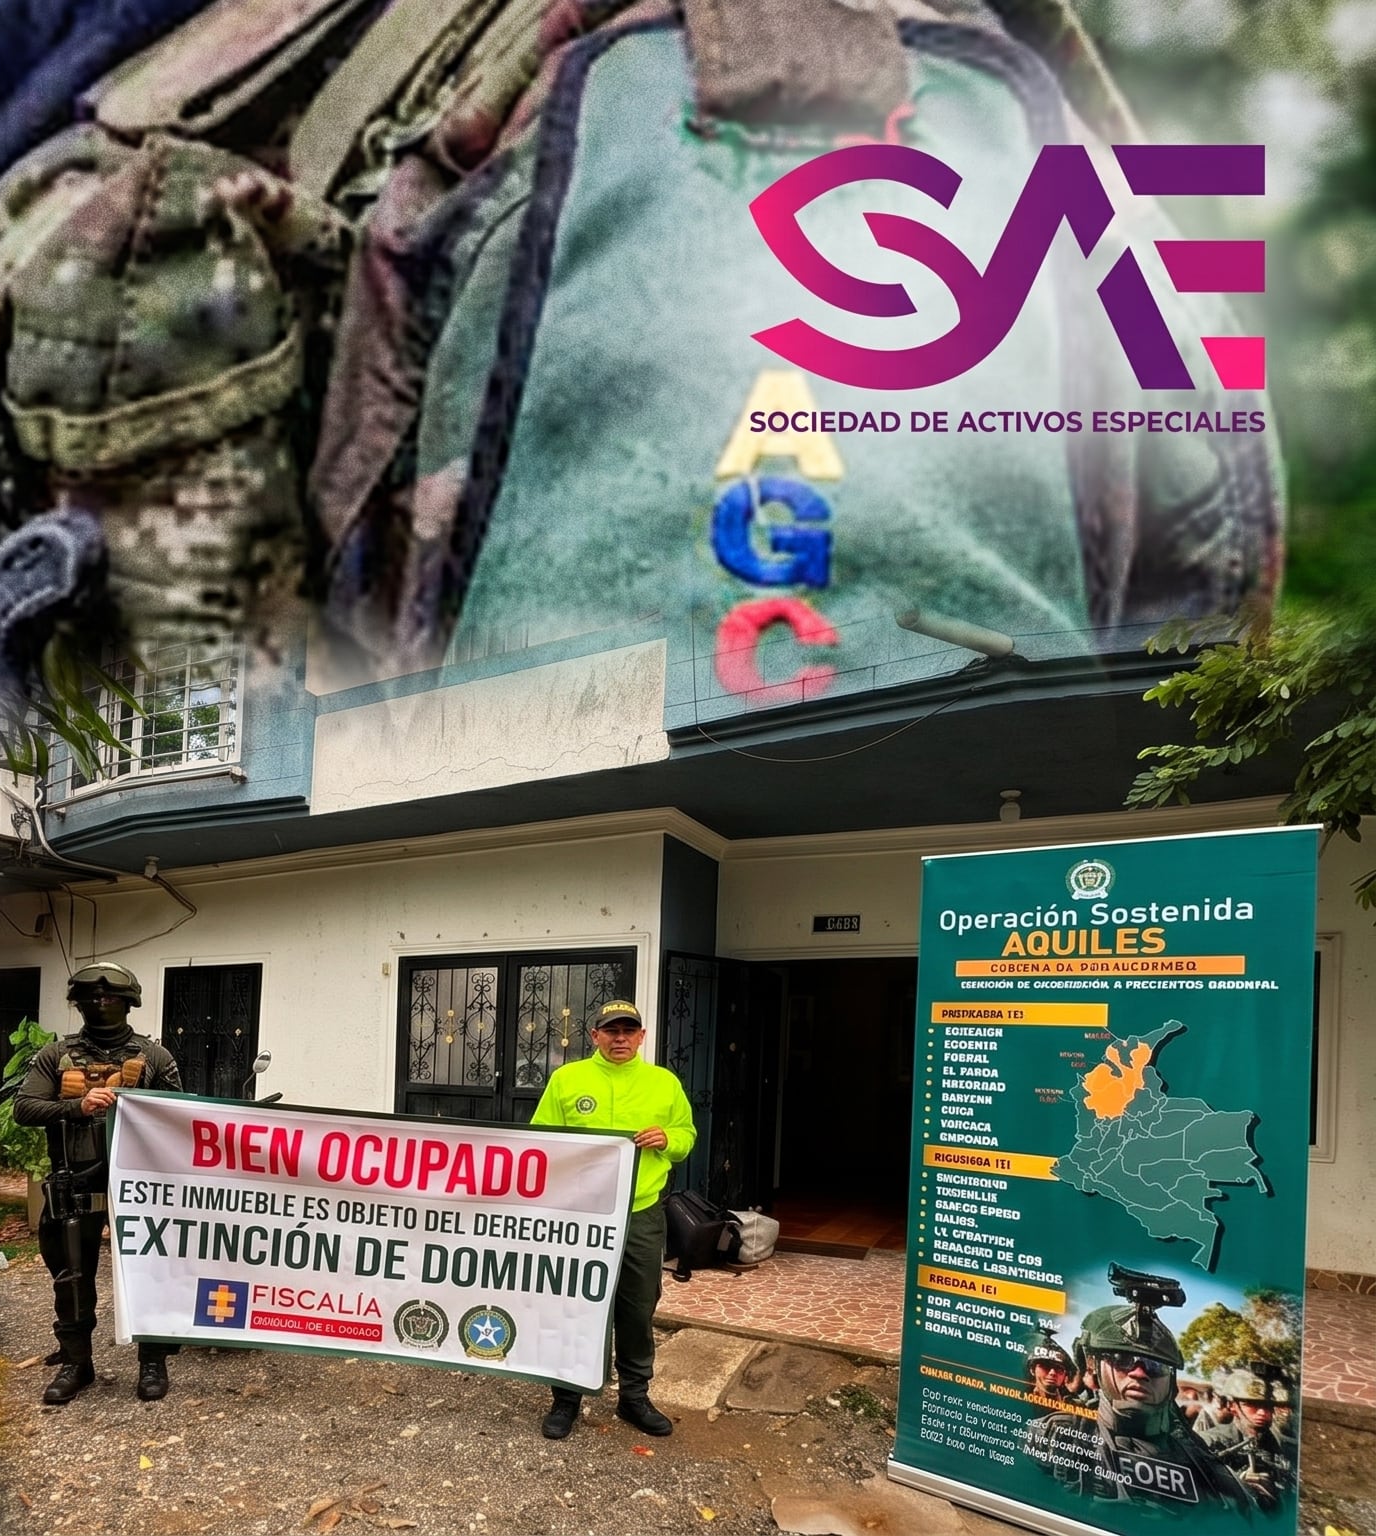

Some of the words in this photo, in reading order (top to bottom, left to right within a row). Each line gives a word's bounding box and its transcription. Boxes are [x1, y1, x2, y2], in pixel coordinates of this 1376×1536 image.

[940, 904, 1077, 936] Operación
[1090, 897, 1254, 926] Sostenida
[1002, 927, 1166, 957] AQUILES
[192, 1119, 303, 1178] BIEN
[317, 1131, 548, 1199] OCUPADO
[119, 1180, 174, 1207] ESTE
[182, 1184, 296, 1217] INMUEBLE
[303, 1196, 330, 1220] ES
[336, 1201, 418, 1229] OBJETO
[424, 1209, 467, 1235] DEL
[473, 1213, 580, 1248] DERECHO
[586, 1223, 617, 1251] DE
[116, 1214, 340, 1274] EXTINCIÓN
[355, 1236, 409, 1280] DE
[423, 1243, 609, 1302] DOMINIO
[253, 1285, 381, 1318] FISCALÍA
